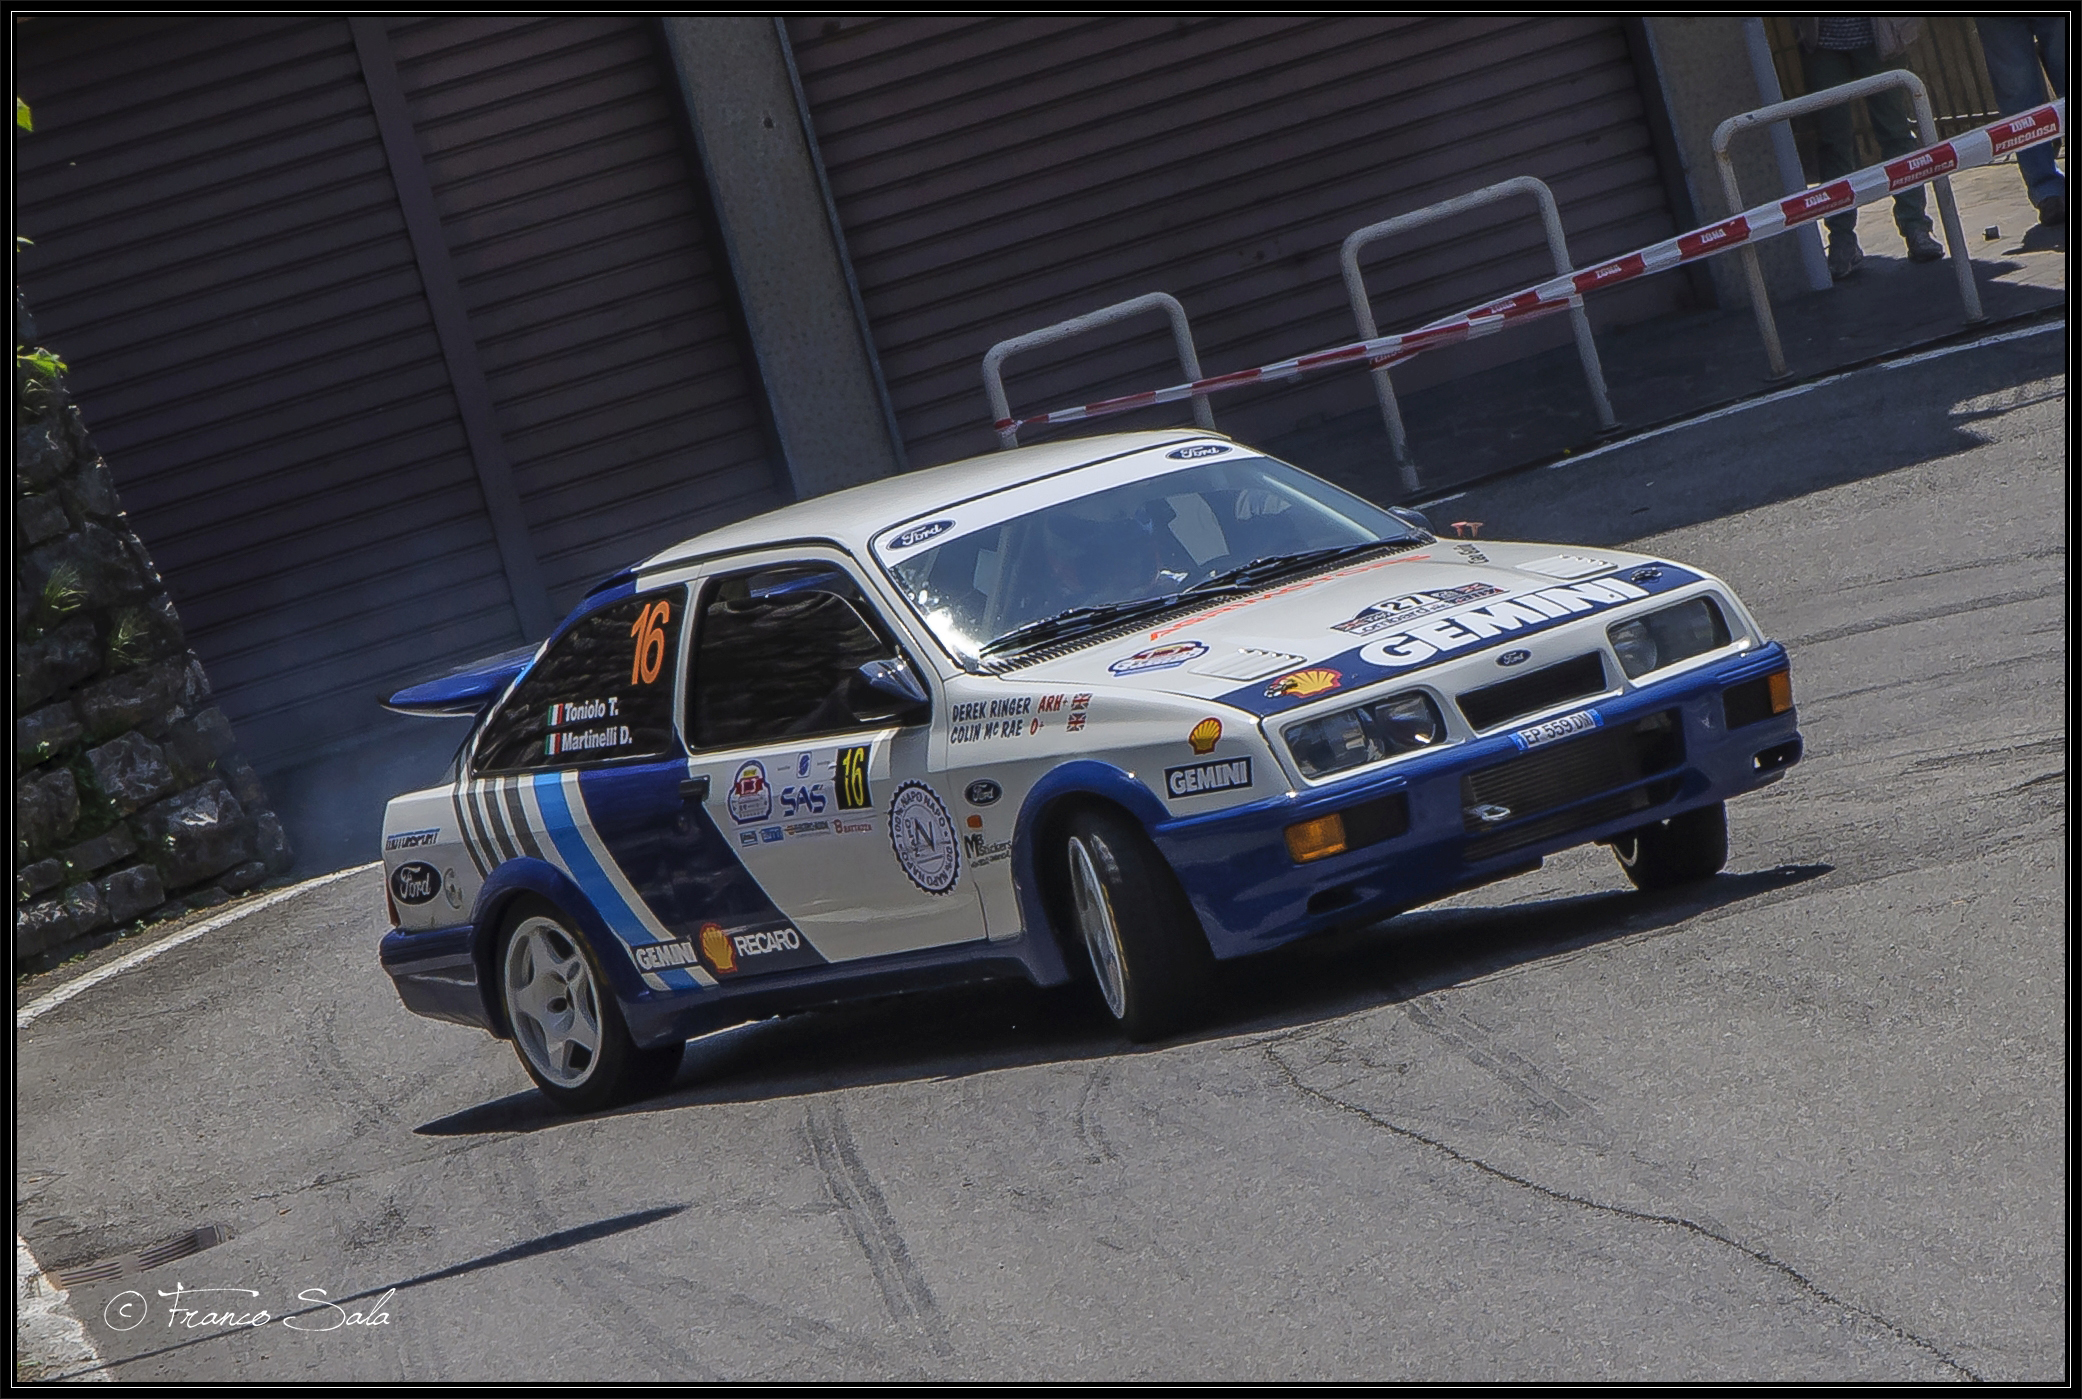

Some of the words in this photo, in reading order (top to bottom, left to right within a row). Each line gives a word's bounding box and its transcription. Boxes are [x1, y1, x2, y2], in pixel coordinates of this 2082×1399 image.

[1995, 122, 2057, 152] PERICOLOSA
[2009, 116, 2036, 133] ZONA
[1906, 153, 1933, 171] ZONA
[1804, 191, 1831, 208] ZONA
[1700, 228, 1726, 244] ZONA
[1179, 446, 1219, 458] Ford
[901, 524, 943, 546] Ford
[1380, 596, 1423, 611] 27
[1360, 577, 1650, 666] GEMINI
[631, 600, 670, 685] 16
[564, 699, 605, 722] Toniolo
[608, 696, 619, 717] T.
[952, 700, 987, 723] DEREK
[989, 697, 1031, 718] RINGER
[561, 726, 617, 751] Martinelli
[620, 725, 632, 745] D.
[950, 722, 981, 744] COLIN
[1000, 718, 1023, 738] RAE
[1521, 728, 1541, 745] EP
[1541, 719, 1573, 739] 559
[842, 747, 864, 807] 16
[1169, 761, 1248, 795] GEMINI
[780, 784, 826, 817] SAS
[400, 866, 432, 899] Ford
[733, 927, 800, 957] RECARO
[635, 942, 698, 970] GEMINI
